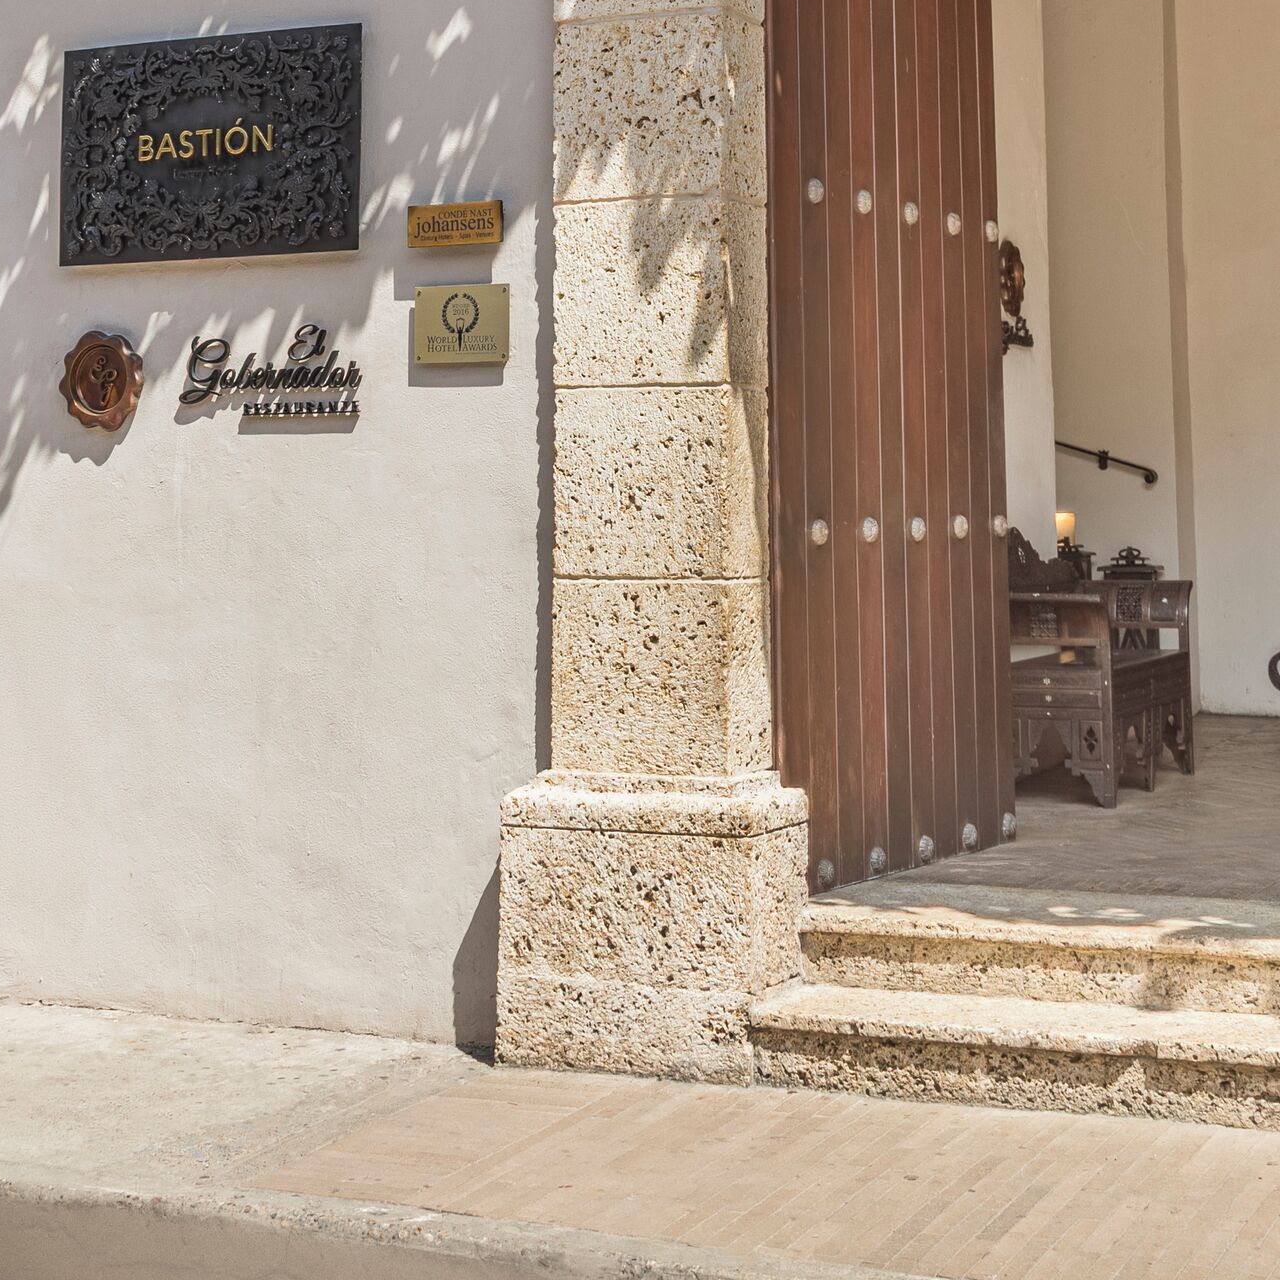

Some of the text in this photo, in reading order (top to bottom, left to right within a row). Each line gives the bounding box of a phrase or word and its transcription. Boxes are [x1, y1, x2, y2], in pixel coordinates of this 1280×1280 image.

[138, 117, 273, 161] BASTIÓN
[438, 207, 493, 219] CONDÉ NAST
[414, 215, 495, 238] johansens
[452, 308, 470, 316] 2016
[288, 324, 327, 362] El
[427, 335, 495, 344] WORLD LUXURY
[427, 343, 498, 352] HOTEL AWARDS
[179, 336, 363, 405] Gobernador
